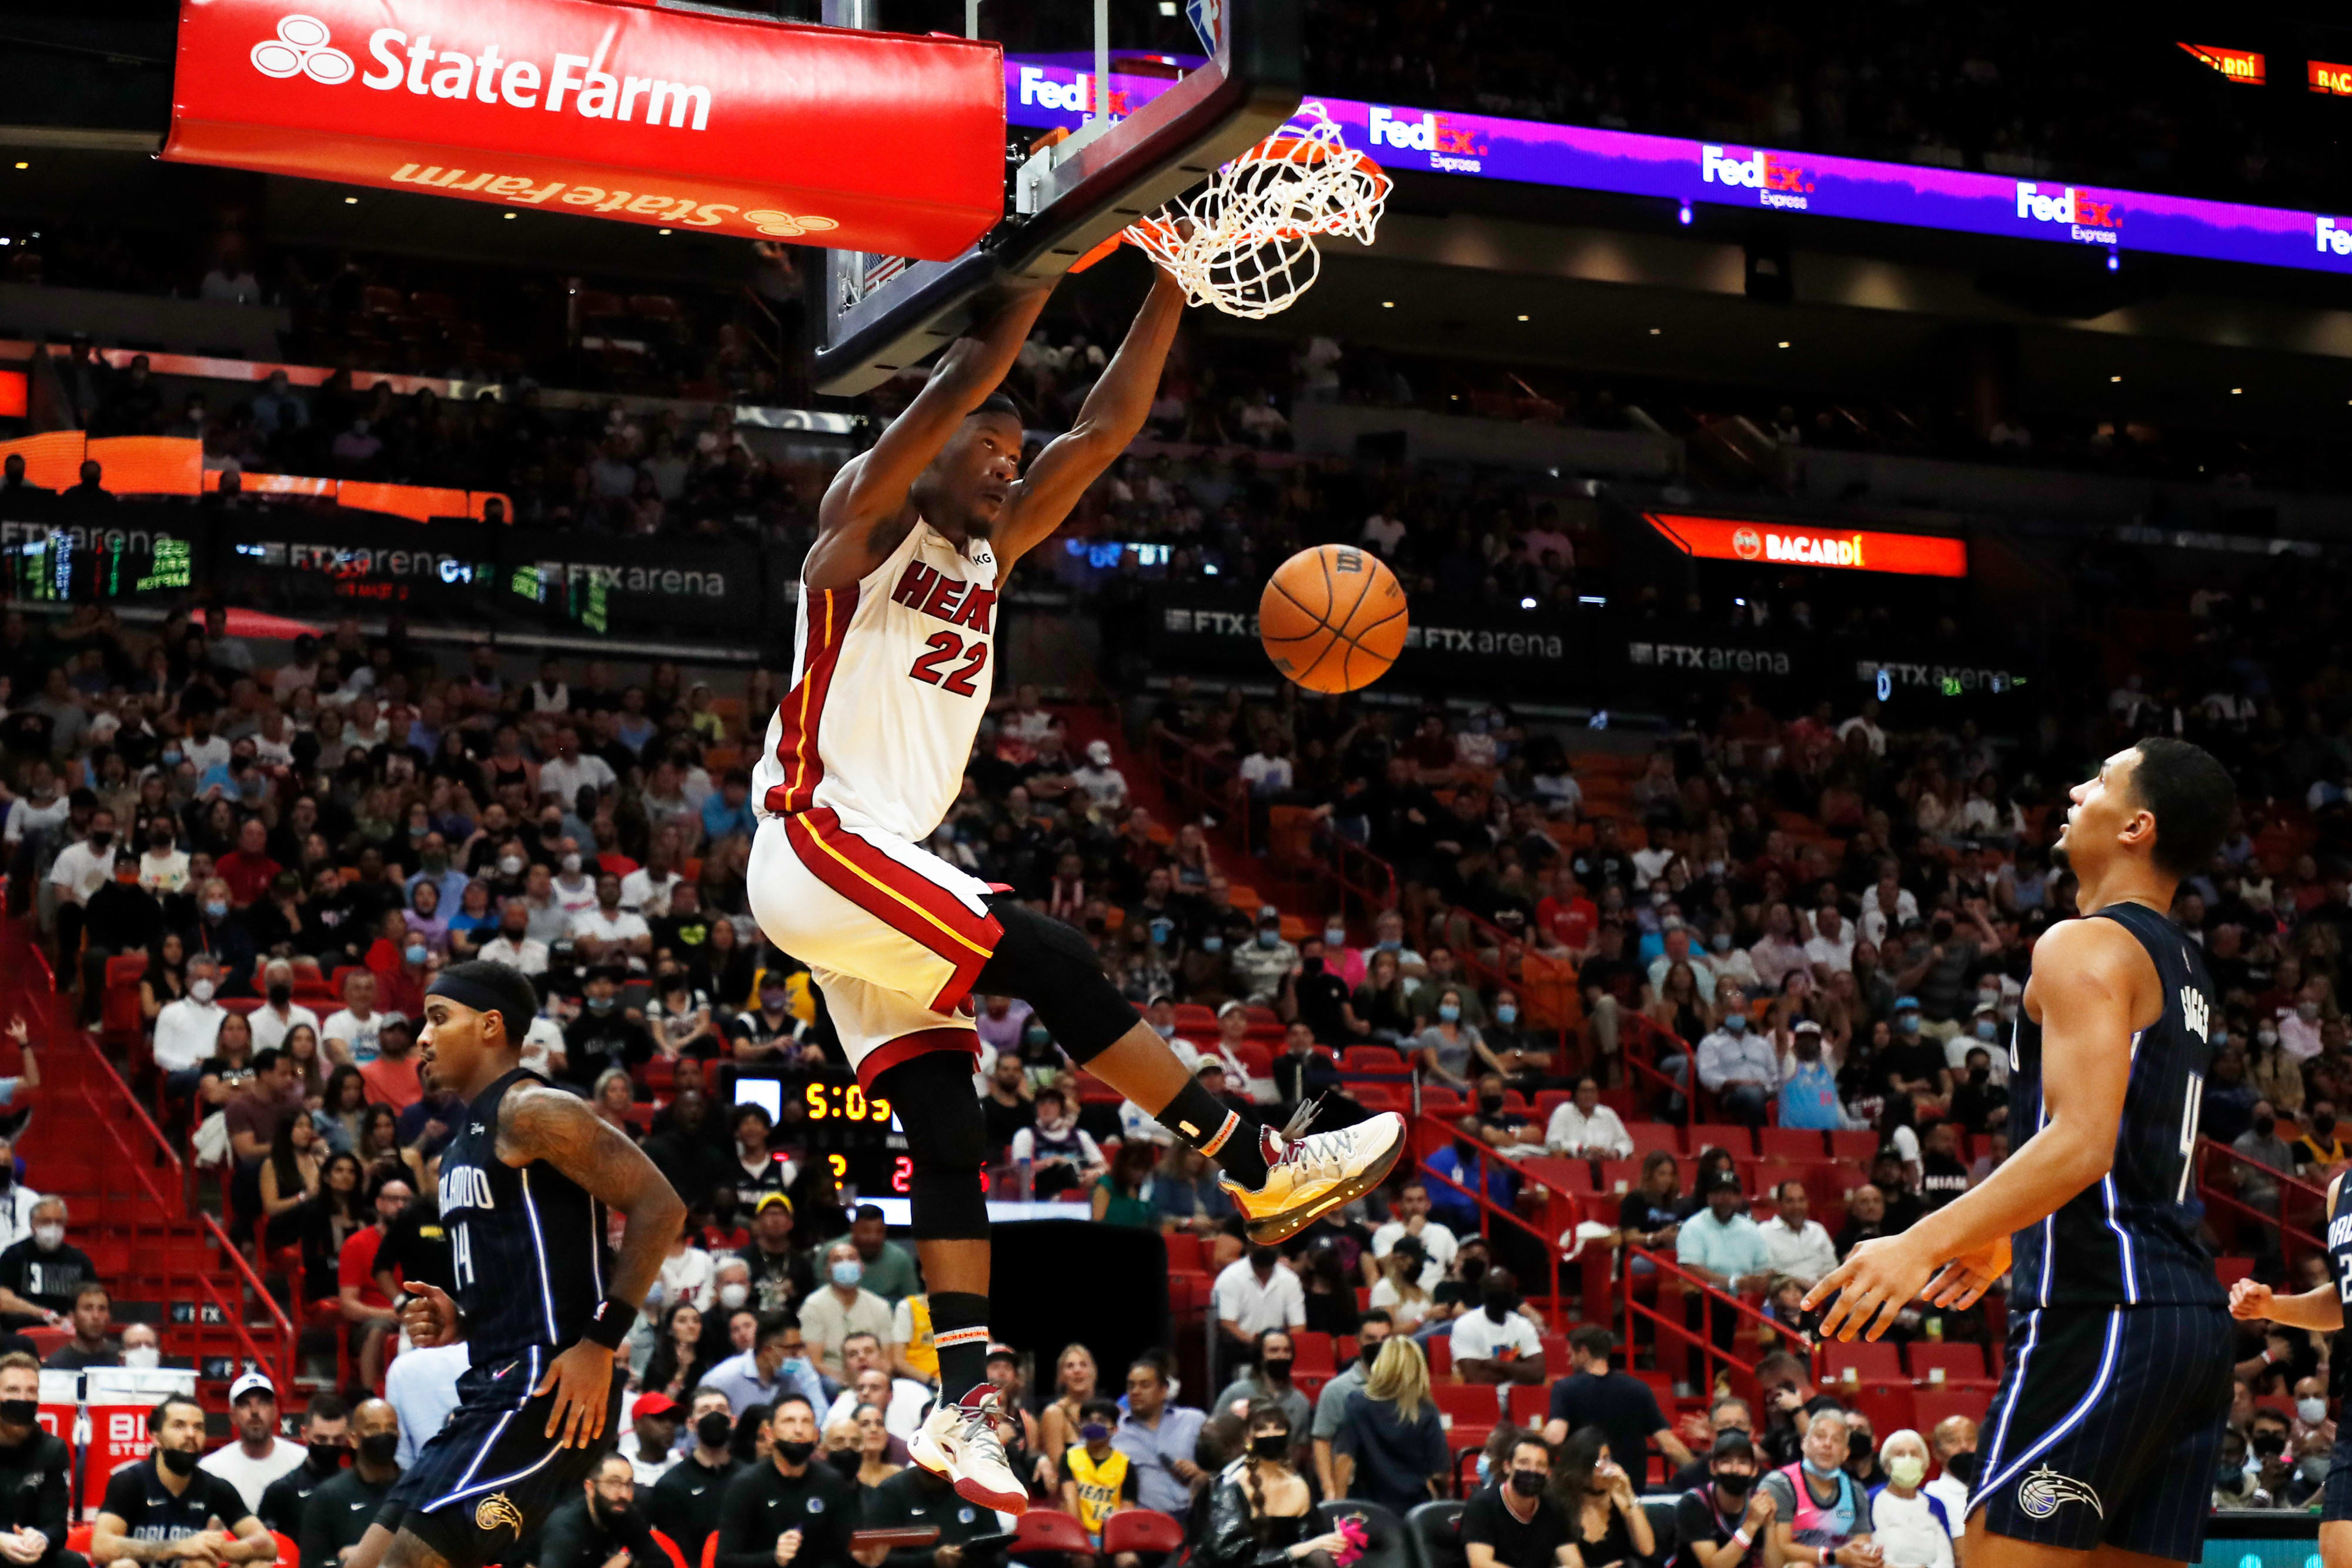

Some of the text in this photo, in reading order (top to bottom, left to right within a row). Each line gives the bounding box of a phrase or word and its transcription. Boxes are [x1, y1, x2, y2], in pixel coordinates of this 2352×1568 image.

[1369, 106, 1477, 155] FedEx
[1702, 145, 1804, 193] FedEx
[2017, 181, 2114, 228] FedEx
[973, 553, 992, 566] KG
[627, 566, 724, 597] arena
[1195, 610, 1245, 631] FTX
[1424, 628, 1563, 658] FTX arena
[908, 630, 988, 698] 22
